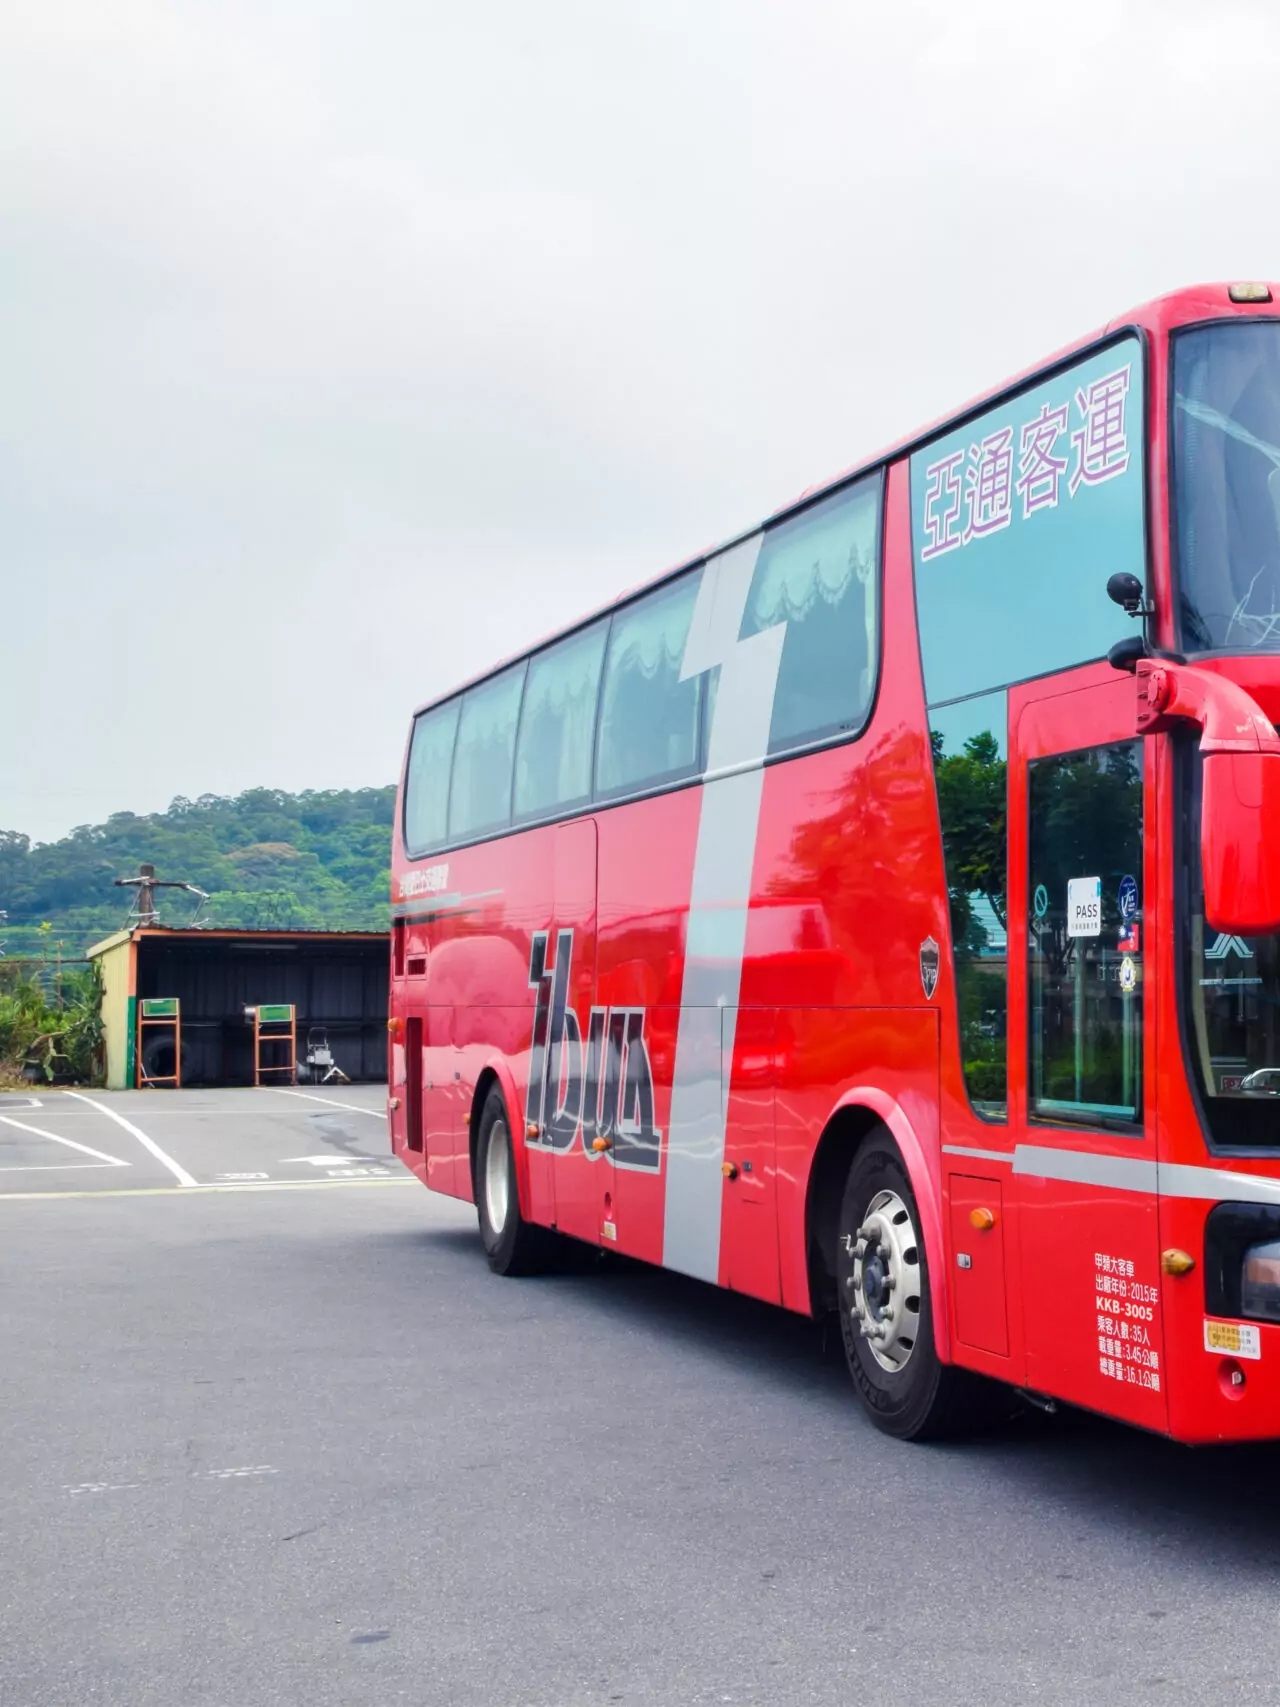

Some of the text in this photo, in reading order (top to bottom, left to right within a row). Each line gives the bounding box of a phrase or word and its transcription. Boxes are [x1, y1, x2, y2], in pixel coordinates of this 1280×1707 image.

[921, 363, 1131, 562] 亞通客運
[1076, 903, 1098, 919] PASS
[1096, 1295, 1153, 1321] KKB-3005
